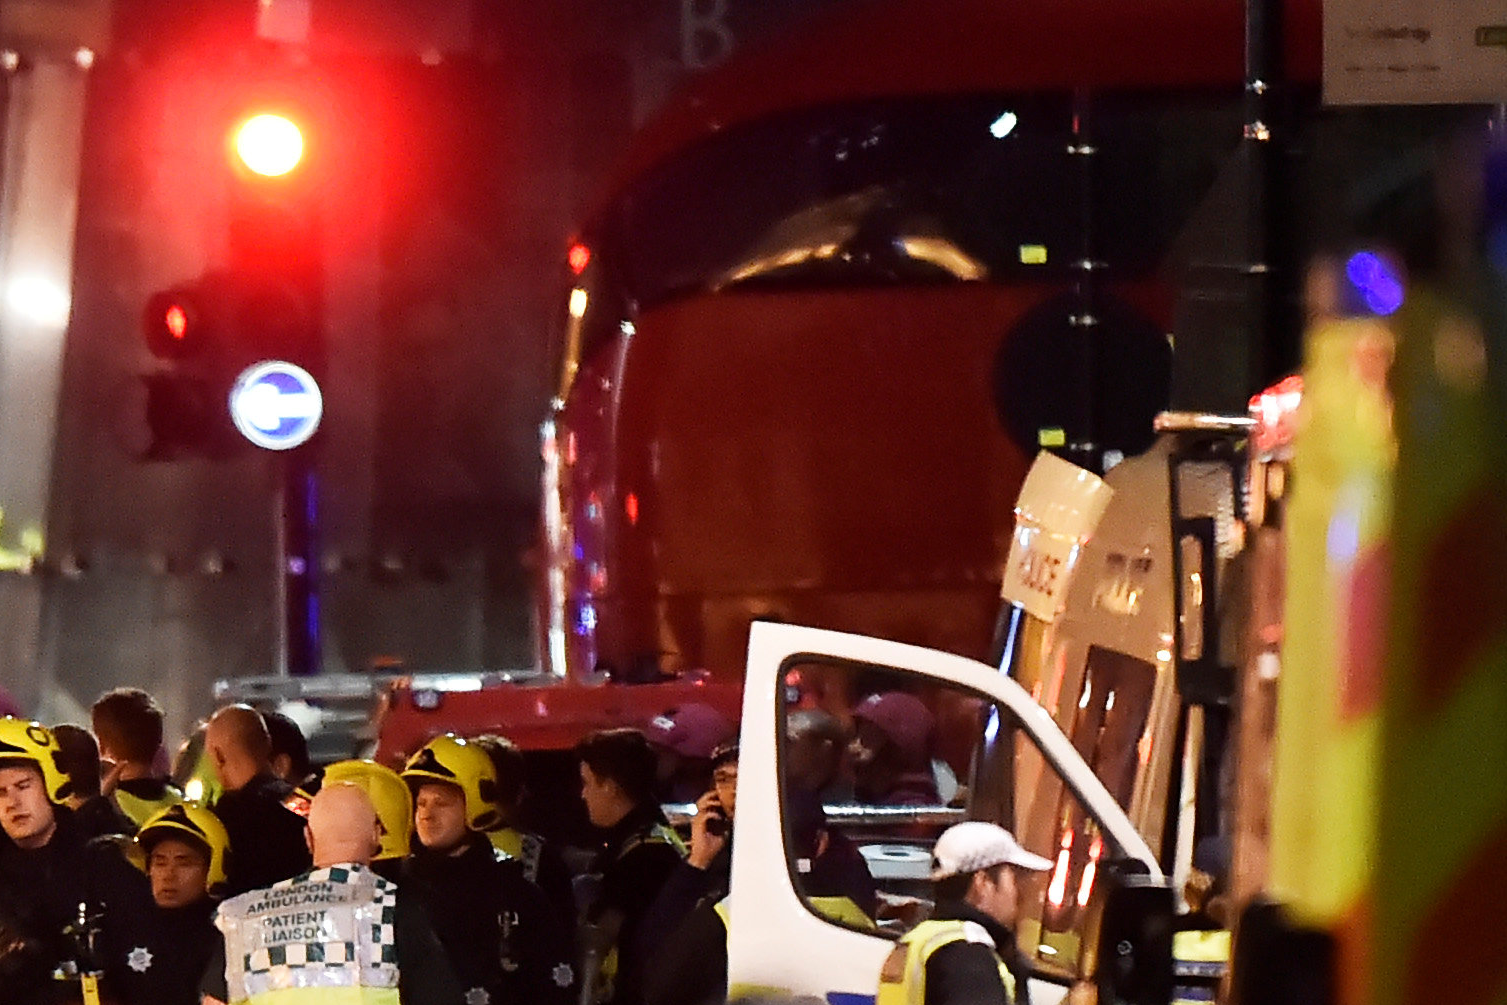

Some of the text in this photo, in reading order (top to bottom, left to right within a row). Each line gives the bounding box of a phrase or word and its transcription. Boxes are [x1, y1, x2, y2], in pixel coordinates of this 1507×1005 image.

[264, 883, 333, 899] LONDON
[247, 894, 346, 914] AMBULANCE
[263, 911, 327, 927] PATIENT
[264, 926, 327, 943] LIAISON
